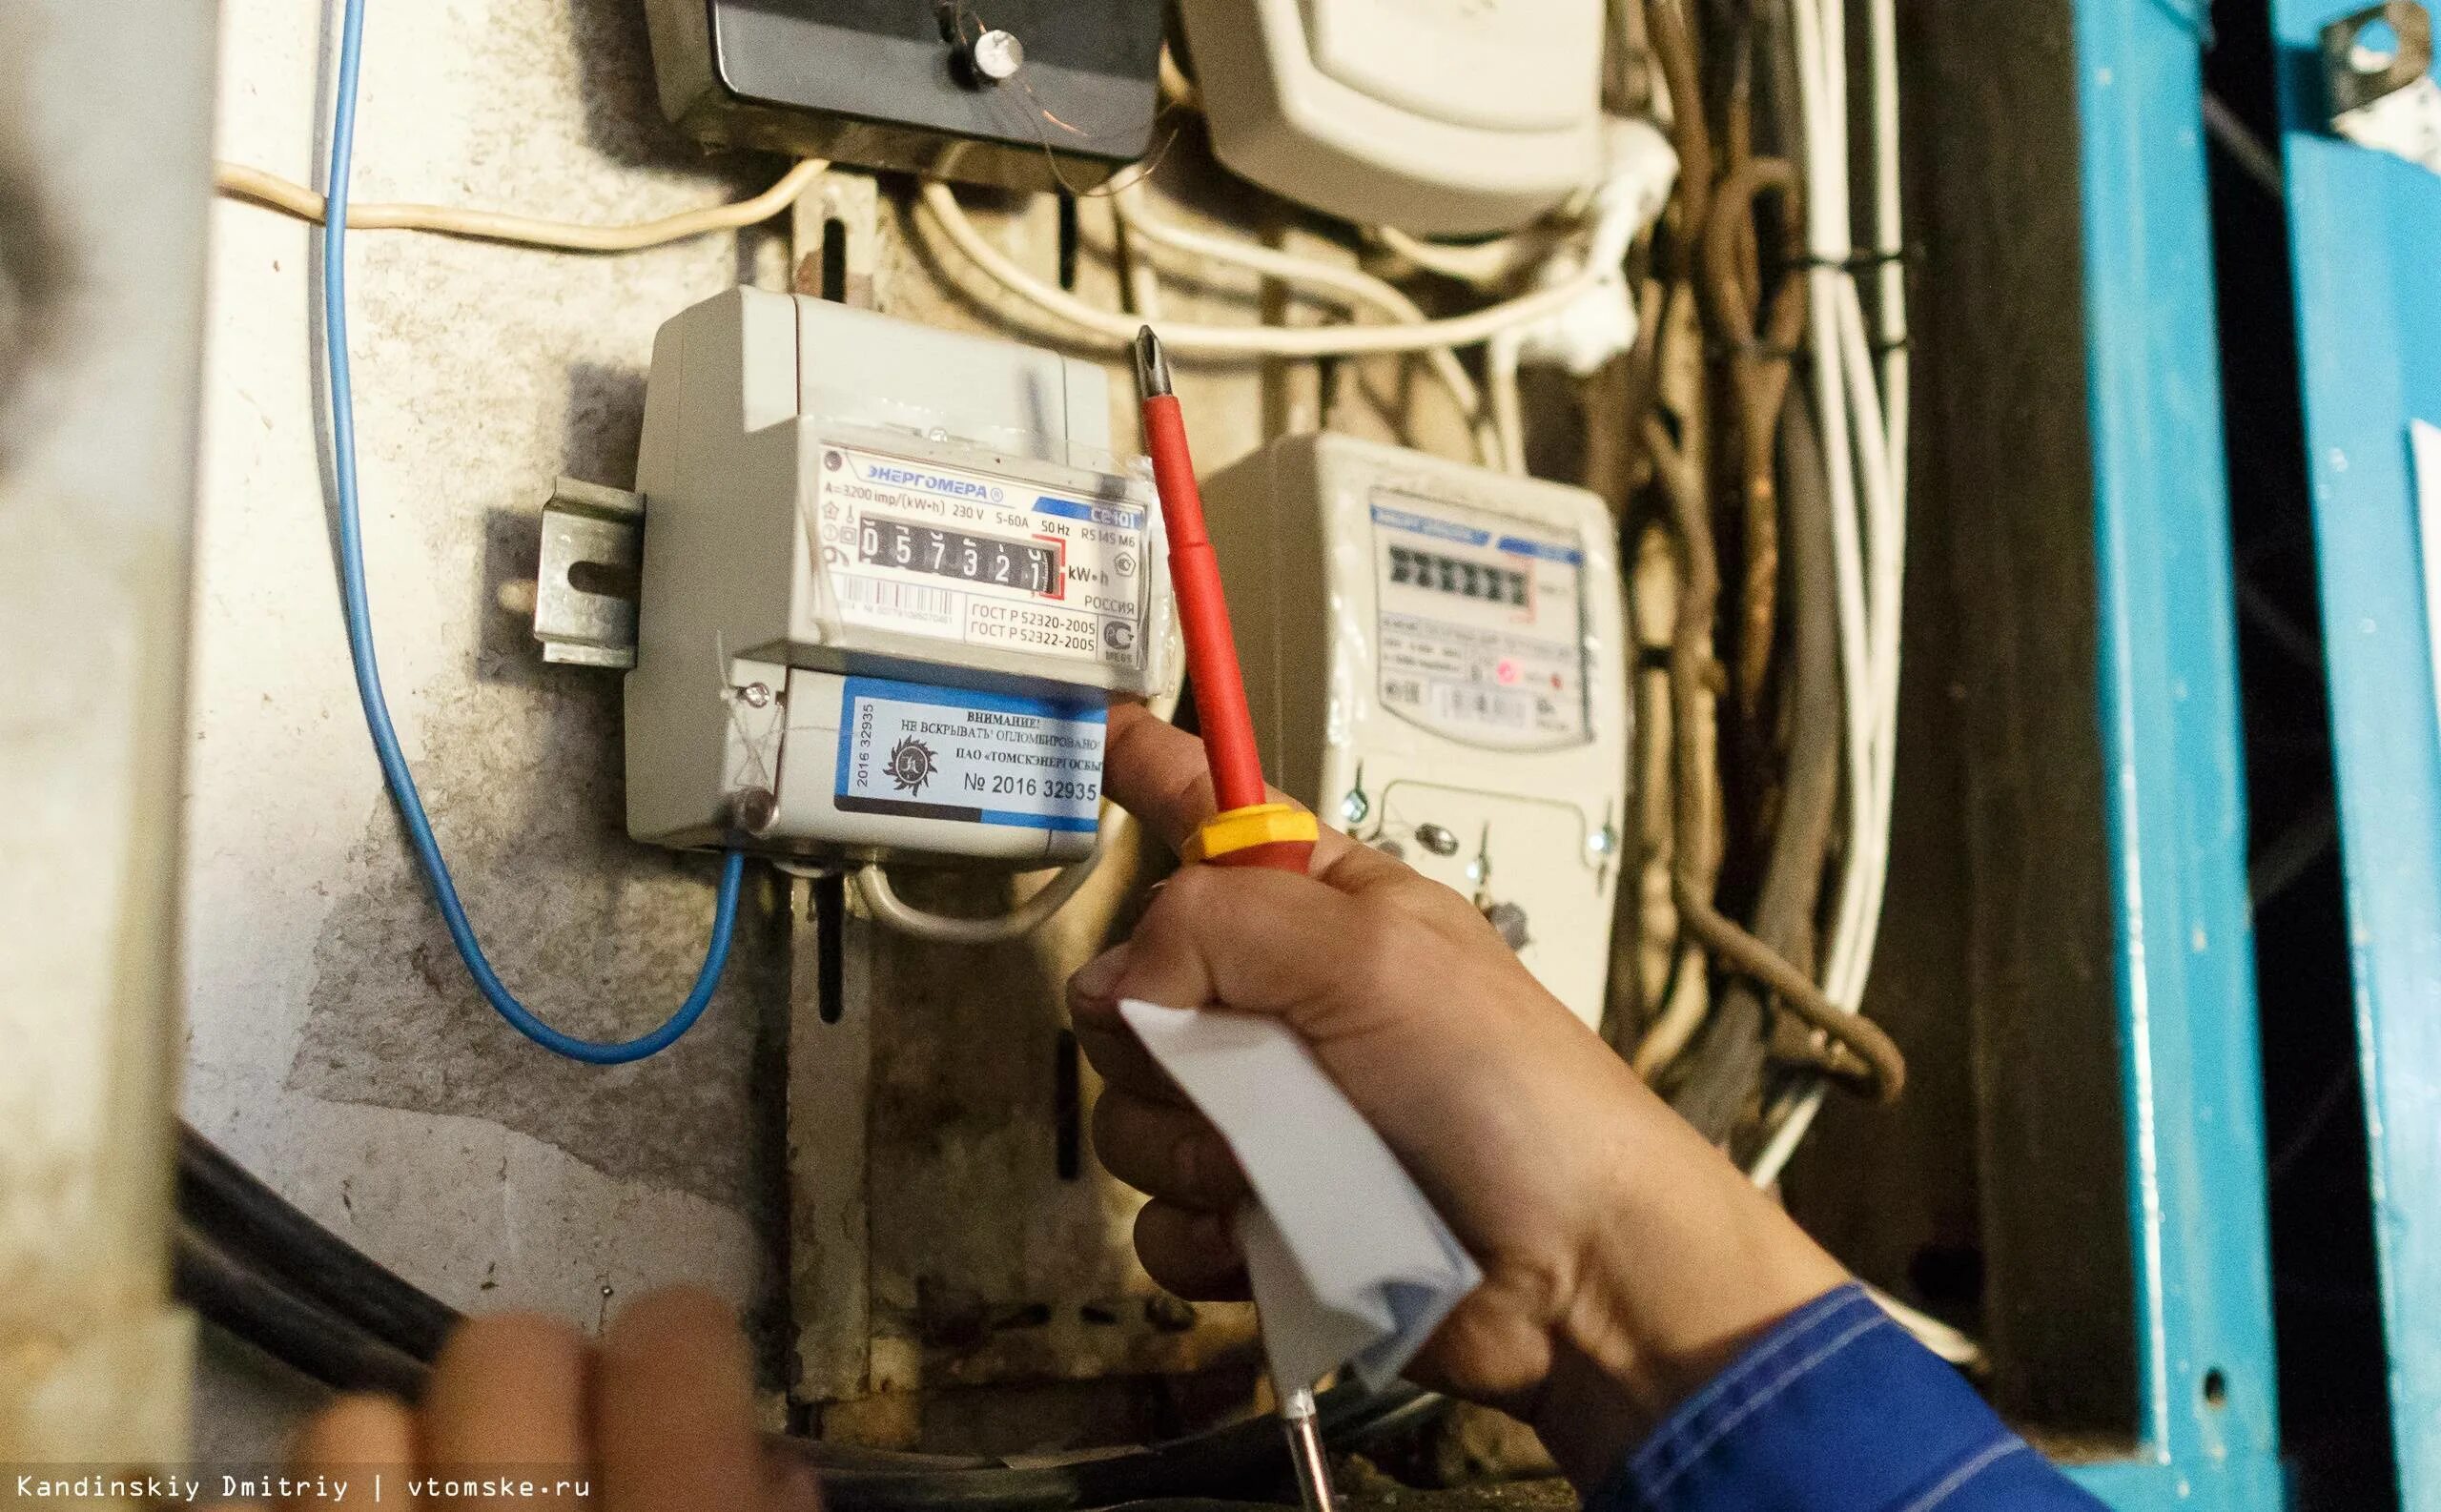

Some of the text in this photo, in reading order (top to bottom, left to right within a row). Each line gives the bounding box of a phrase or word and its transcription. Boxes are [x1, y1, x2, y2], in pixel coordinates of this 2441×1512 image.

[953, 503, 974, 519] 230
[976, 509, 984, 521] V
[1041, 520, 1055, 534] 50
[1057, 524, 1071, 537] Hz
[972, 603, 1007, 620] ГОСТ
[1021, 611, 1096, 635] 52320-2005
[1084, 595, 1135, 615] РОССИЯ
[971, 621, 1006, 638] ГОСТ
[1020, 628, 1095, 651] 52322-2005
[901, 720, 917, 731] НЕ
[967, 711, 1040, 729] ВНИМАНИЕ!
[857, 704, 873, 787] 2016 32935
[956, 747, 982, 761] ПАО
[964, 772, 1097, 802] № 2016 32935
